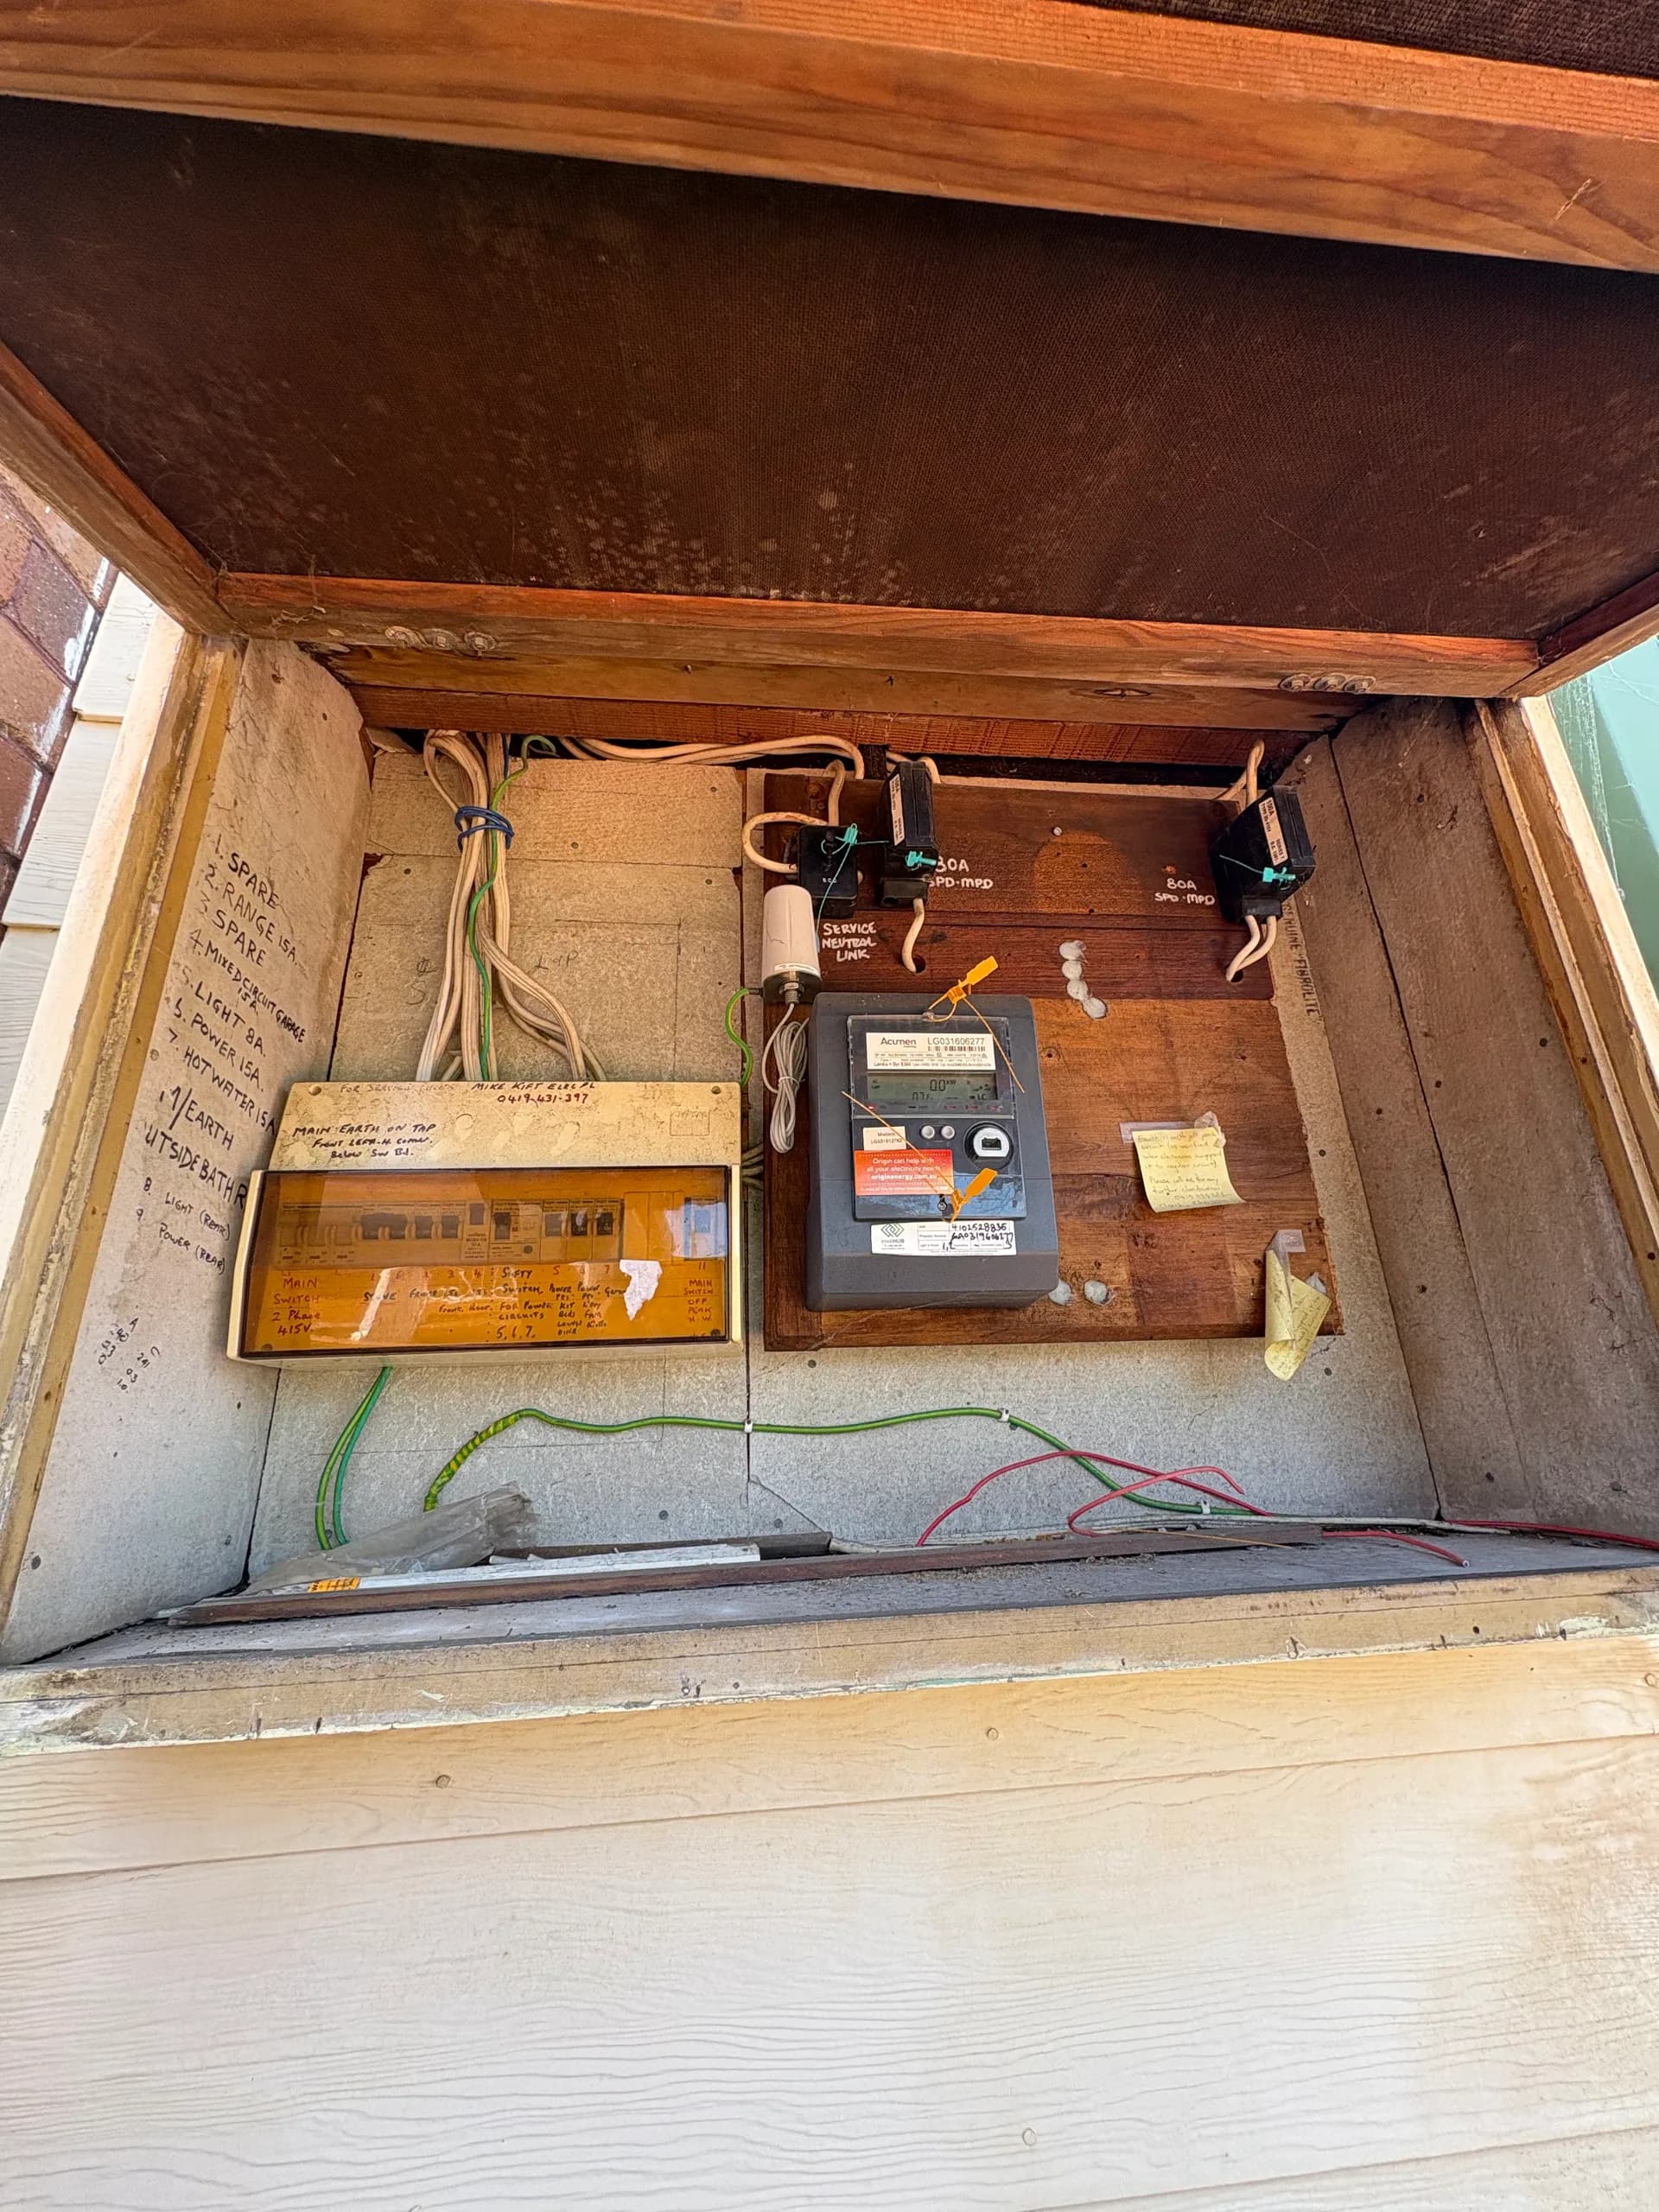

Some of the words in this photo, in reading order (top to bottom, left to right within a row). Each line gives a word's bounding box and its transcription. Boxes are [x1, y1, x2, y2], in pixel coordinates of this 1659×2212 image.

[228, 852, 279, 910] SPARE
[1166, 878, 1198, 891] 80A
[222, 881, 276, 944] RANGE
[822, 921, 877, 936] SERVICE
[1282, 901, 1303, 951] GENUINE
[212, 909, 267, 968] SPARE
[821, 936, 877, 950] NEUTRAL
[836, 950, 871, 962] LINK
[194, 981, 245, 1029] LIGHT
[190, 1012, 238, 1068] POWER
[880, 1037, 917, 1046] Acumen
[292, 1125, 331, 1137] MAIN
[339, 1123, 379, 1135] EARTH
[388, 1123, 407, 1133] ON
[412, 1123, 437, 1133] TAP
[198, 1158, 235, 1204] BATH
[164, 1192, 194, 1215] LIGHT
[159, 1222, 191, 1251] POWER
[283, 1276, 318, 1290] MAIN
[273, 1293, 321, 1306] SWITCH
